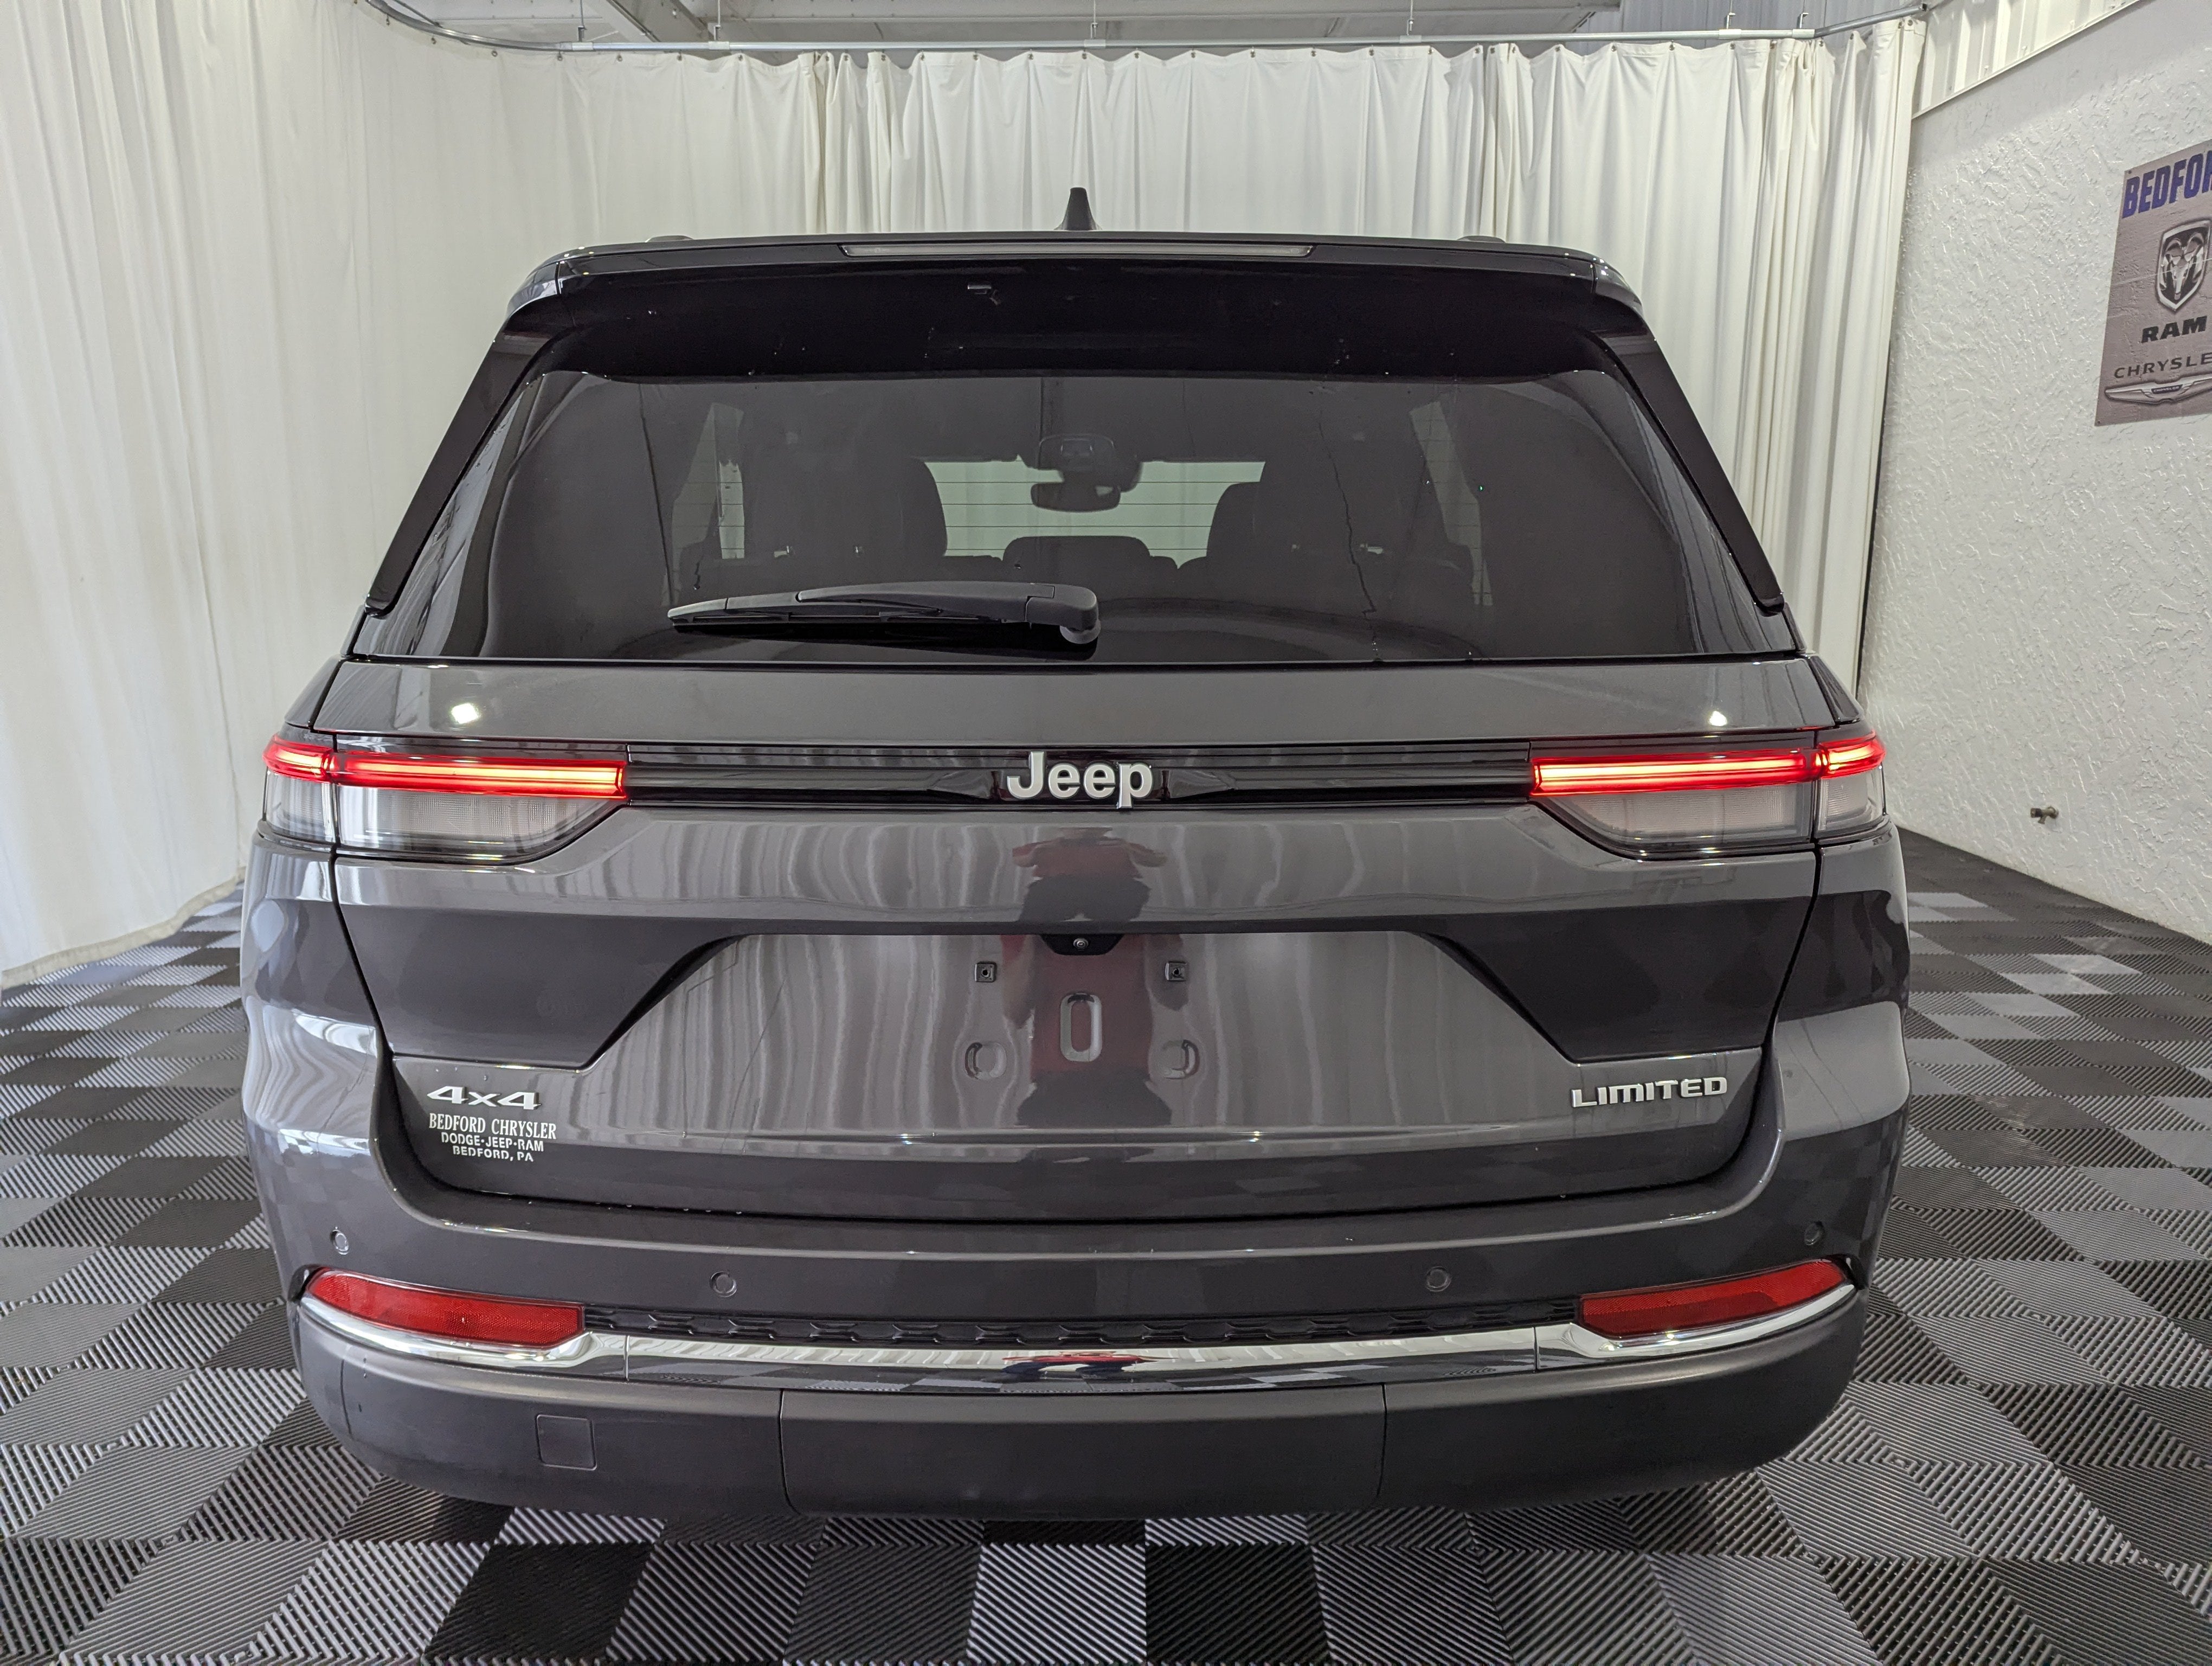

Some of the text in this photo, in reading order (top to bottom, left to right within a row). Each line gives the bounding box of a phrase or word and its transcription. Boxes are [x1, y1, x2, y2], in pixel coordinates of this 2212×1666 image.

[2141, 316, 2208, 343] RAM
[1007, 751, 1153, 809] Jeep
[427, 1086, 542, 1110] 4x4
[1571, 1077, 1727, 1107] LIMITED
[429, 1113, 556, 1139] BEDFORD CHRYSLER
[453, 1145, 534, 1162] BEDFORD, PA
